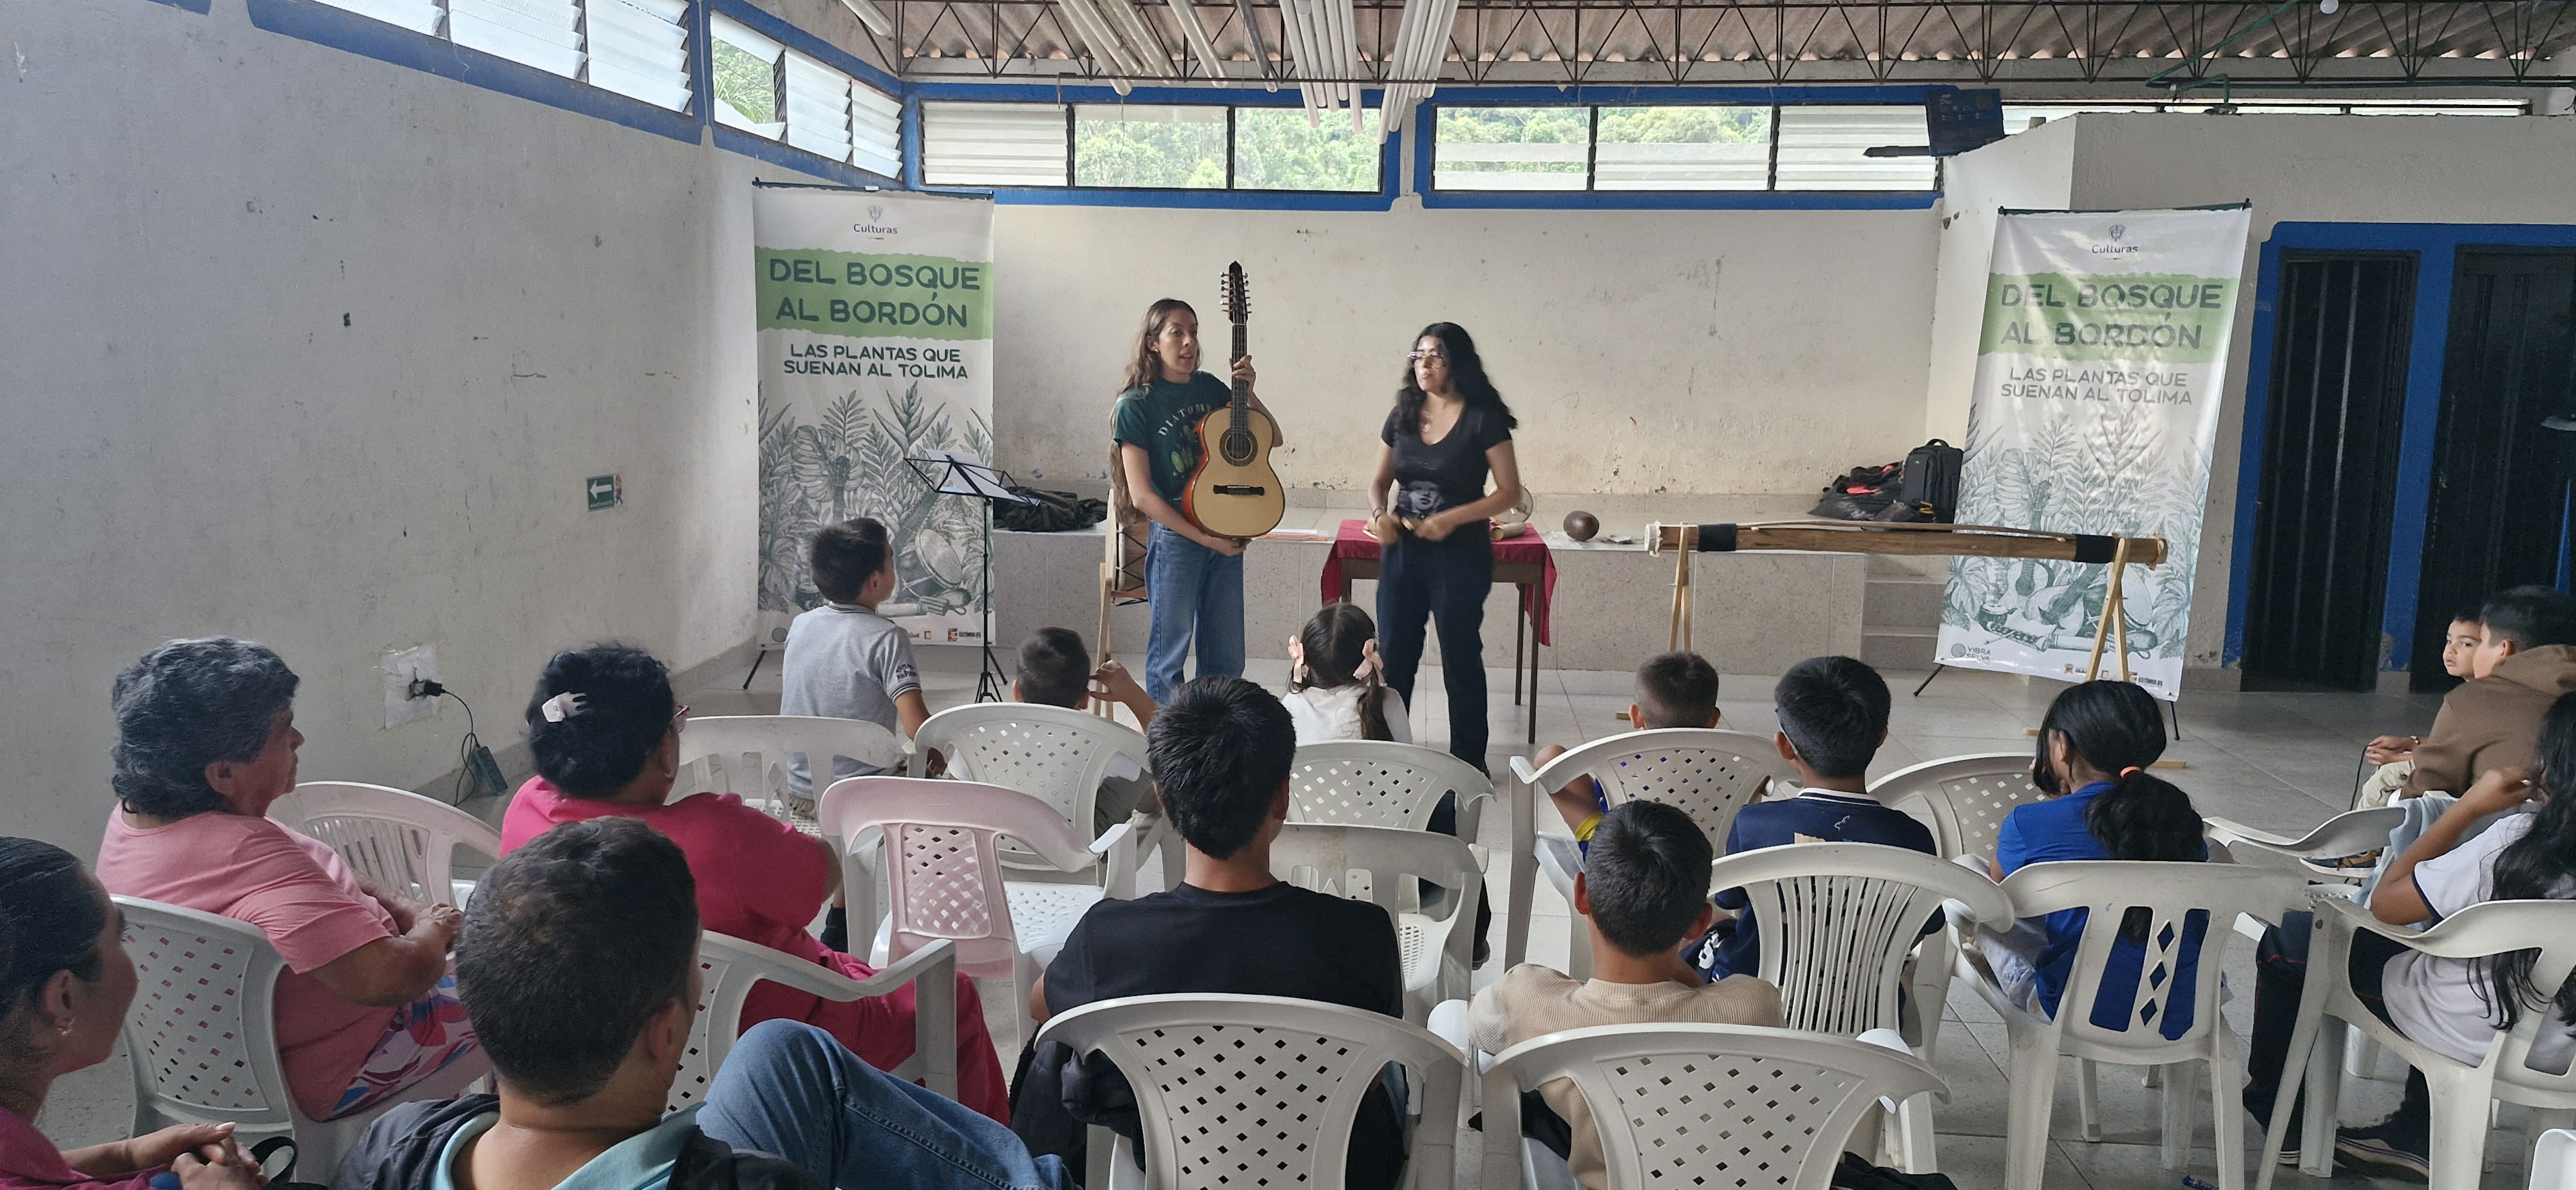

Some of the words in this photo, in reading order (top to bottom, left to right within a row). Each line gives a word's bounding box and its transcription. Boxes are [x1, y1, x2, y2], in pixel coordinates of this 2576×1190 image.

[853, 223, 898, 235] Culturas
[2091, 244, 2139, 254] Culturas
[770, 259, 836, 285] DEL
[847, 262, 981, 290] BOSQUE
[2001, 283, 2066, 308] DEL
[2077, 284, 2224, 309] BOSQUE
[775, 297, 820, 322] AL
[830, 292, 967, 328] BORDÓN
[2000, 321, 2044, 345] AL
[2054, 312, 2202, 350] BORDÓN
[790, 343, 828, 359] LAS
[833, 345, 917, 361] PLANTAS
[923, 348, 961, 363] QUE
[783, 360, 862, 377] SUENAN
[867, 363, 893, 378] AL
[898, 363, 969, 379] TOLIMA
[2009, 366, 2047, 382] LAS
[2052, 368, 2139, 385] PLANTAS
[2145, 371, 2188, 387] QUE
[2000, 384, 2079, 401] SUENAN
[2083, 386, 2109, 402] AL
[2116, 388, 2192, 405] TOLIMA
[1967, 646, 1991, 655] VIBRA
